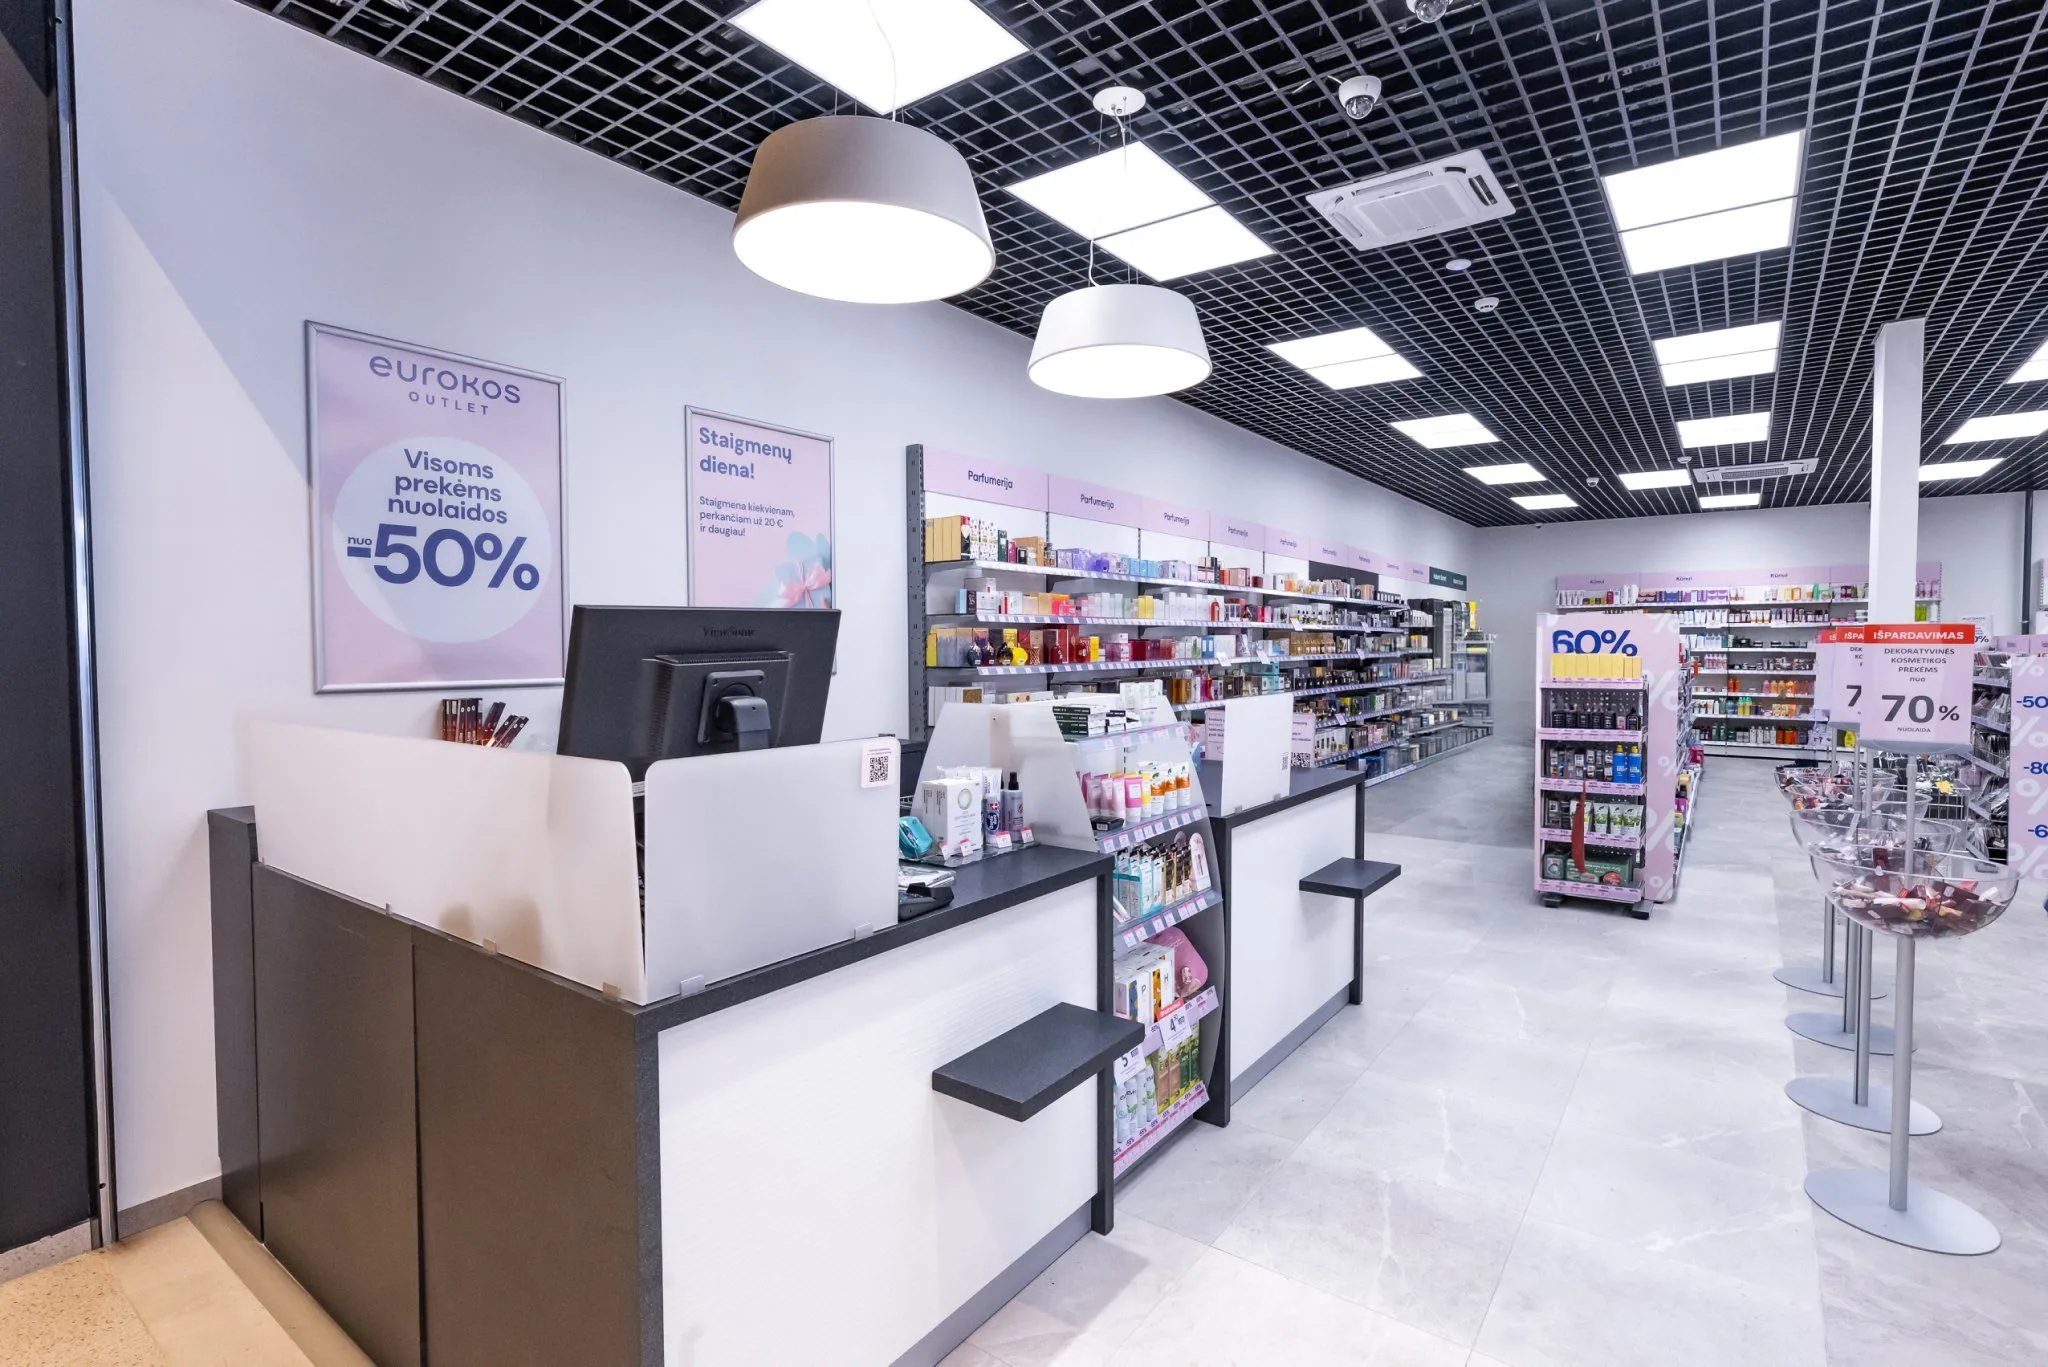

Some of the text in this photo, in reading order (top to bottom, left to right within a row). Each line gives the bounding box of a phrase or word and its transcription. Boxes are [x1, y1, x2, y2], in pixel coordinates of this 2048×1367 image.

[369, 356, 521, 404] eurokos
[409, 391, 489, 415] OUTLET
[699, 427, 792, 464] Staigmenų
[404, 448, 494, 479] Visoms
[699, 455, 755, 479] diena!
[395, 475, 502, 503] prekėms
[967, 470, 1013, 490] Parfumerija
[388, 498, 508, 524] nuolaidos
[699, 495, 796, 518] Staigmena kiekvienam,
[1080, 494, 1115, 510] Parfumerija
[699, 511, 784, 528] perkančiam už 20 €
[700, 524, 746, 538] ir daugiau!
[1163, 512, 1190, 526] Parfumerija
[347, 536, 373, 546] nuo
[347, 523, 540, 591] -50%
[1552, 629, 1638, 657] 60%
[1873, 629, 1965, 640] IŠPARDAVIMAS
